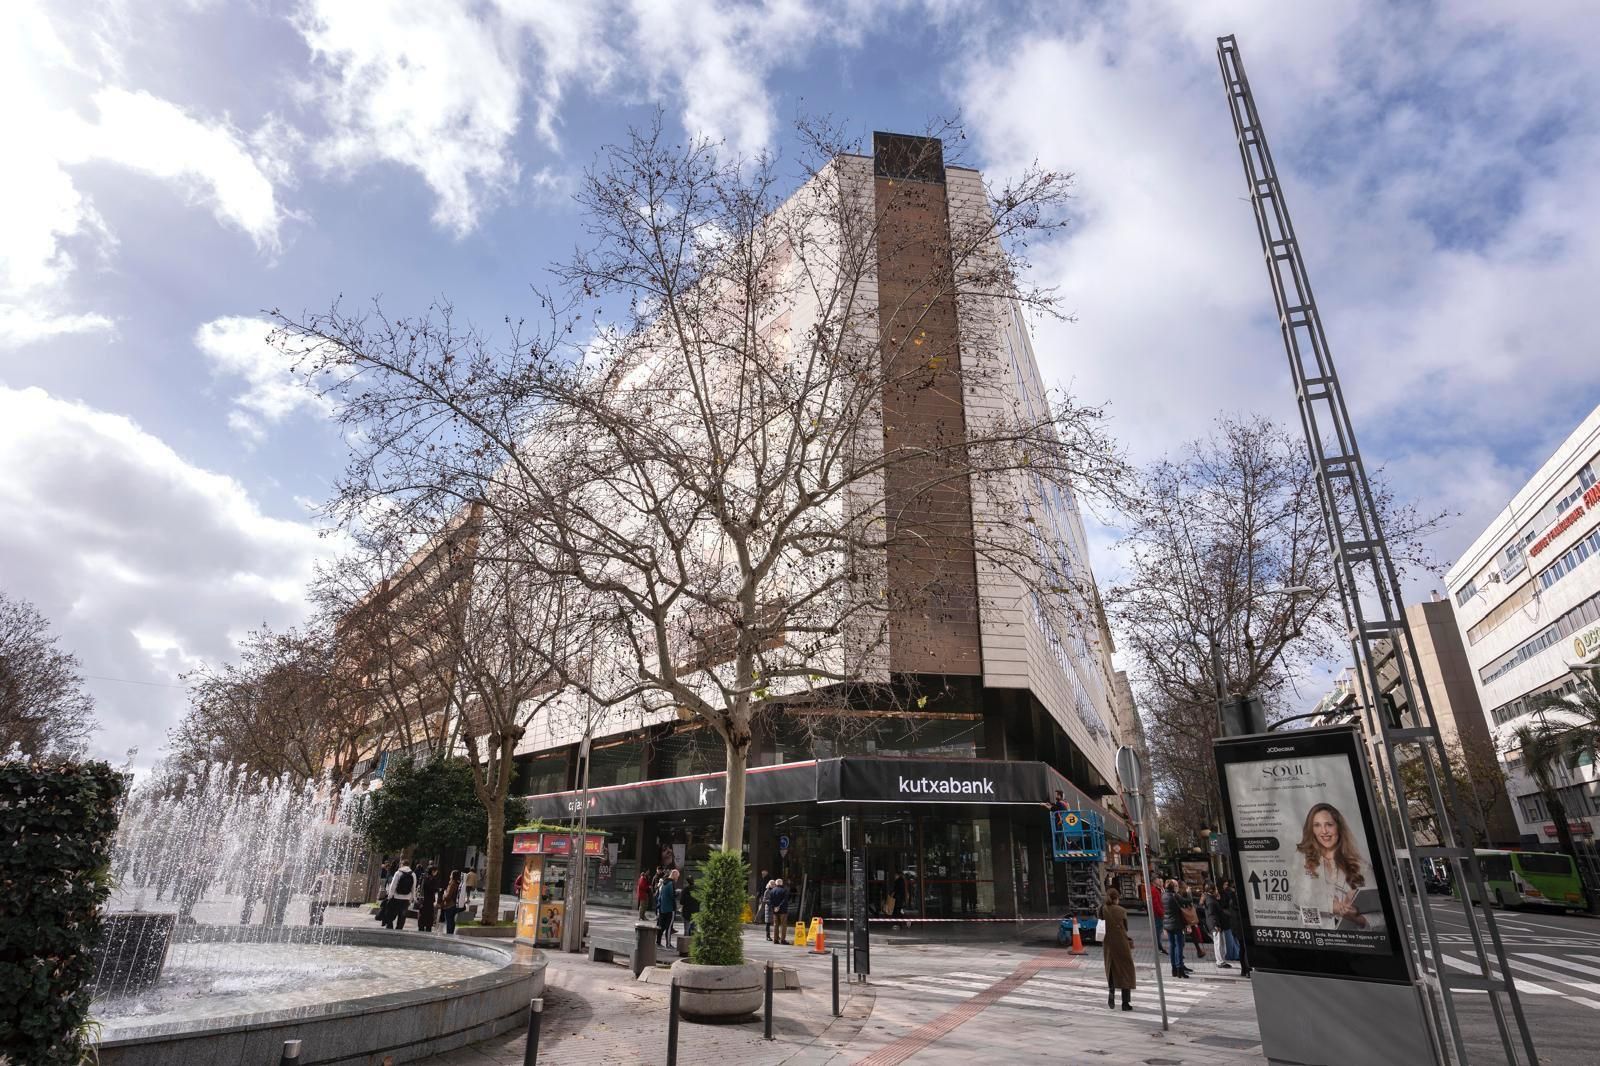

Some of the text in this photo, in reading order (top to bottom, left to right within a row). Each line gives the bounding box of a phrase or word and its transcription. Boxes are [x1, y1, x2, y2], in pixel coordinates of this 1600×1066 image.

[1262, 764, 1310, 778] SOUL
[899, 775, 994, 794] kutxabank
[699, 782, 708, 806] k
[1269, 869, 1288, 877] SOLO
[1262, 877, 1289, 893] 120
[1265, 893, 1292, 901] METROS
[1256, 929, 1311, 939] 654 730 730
